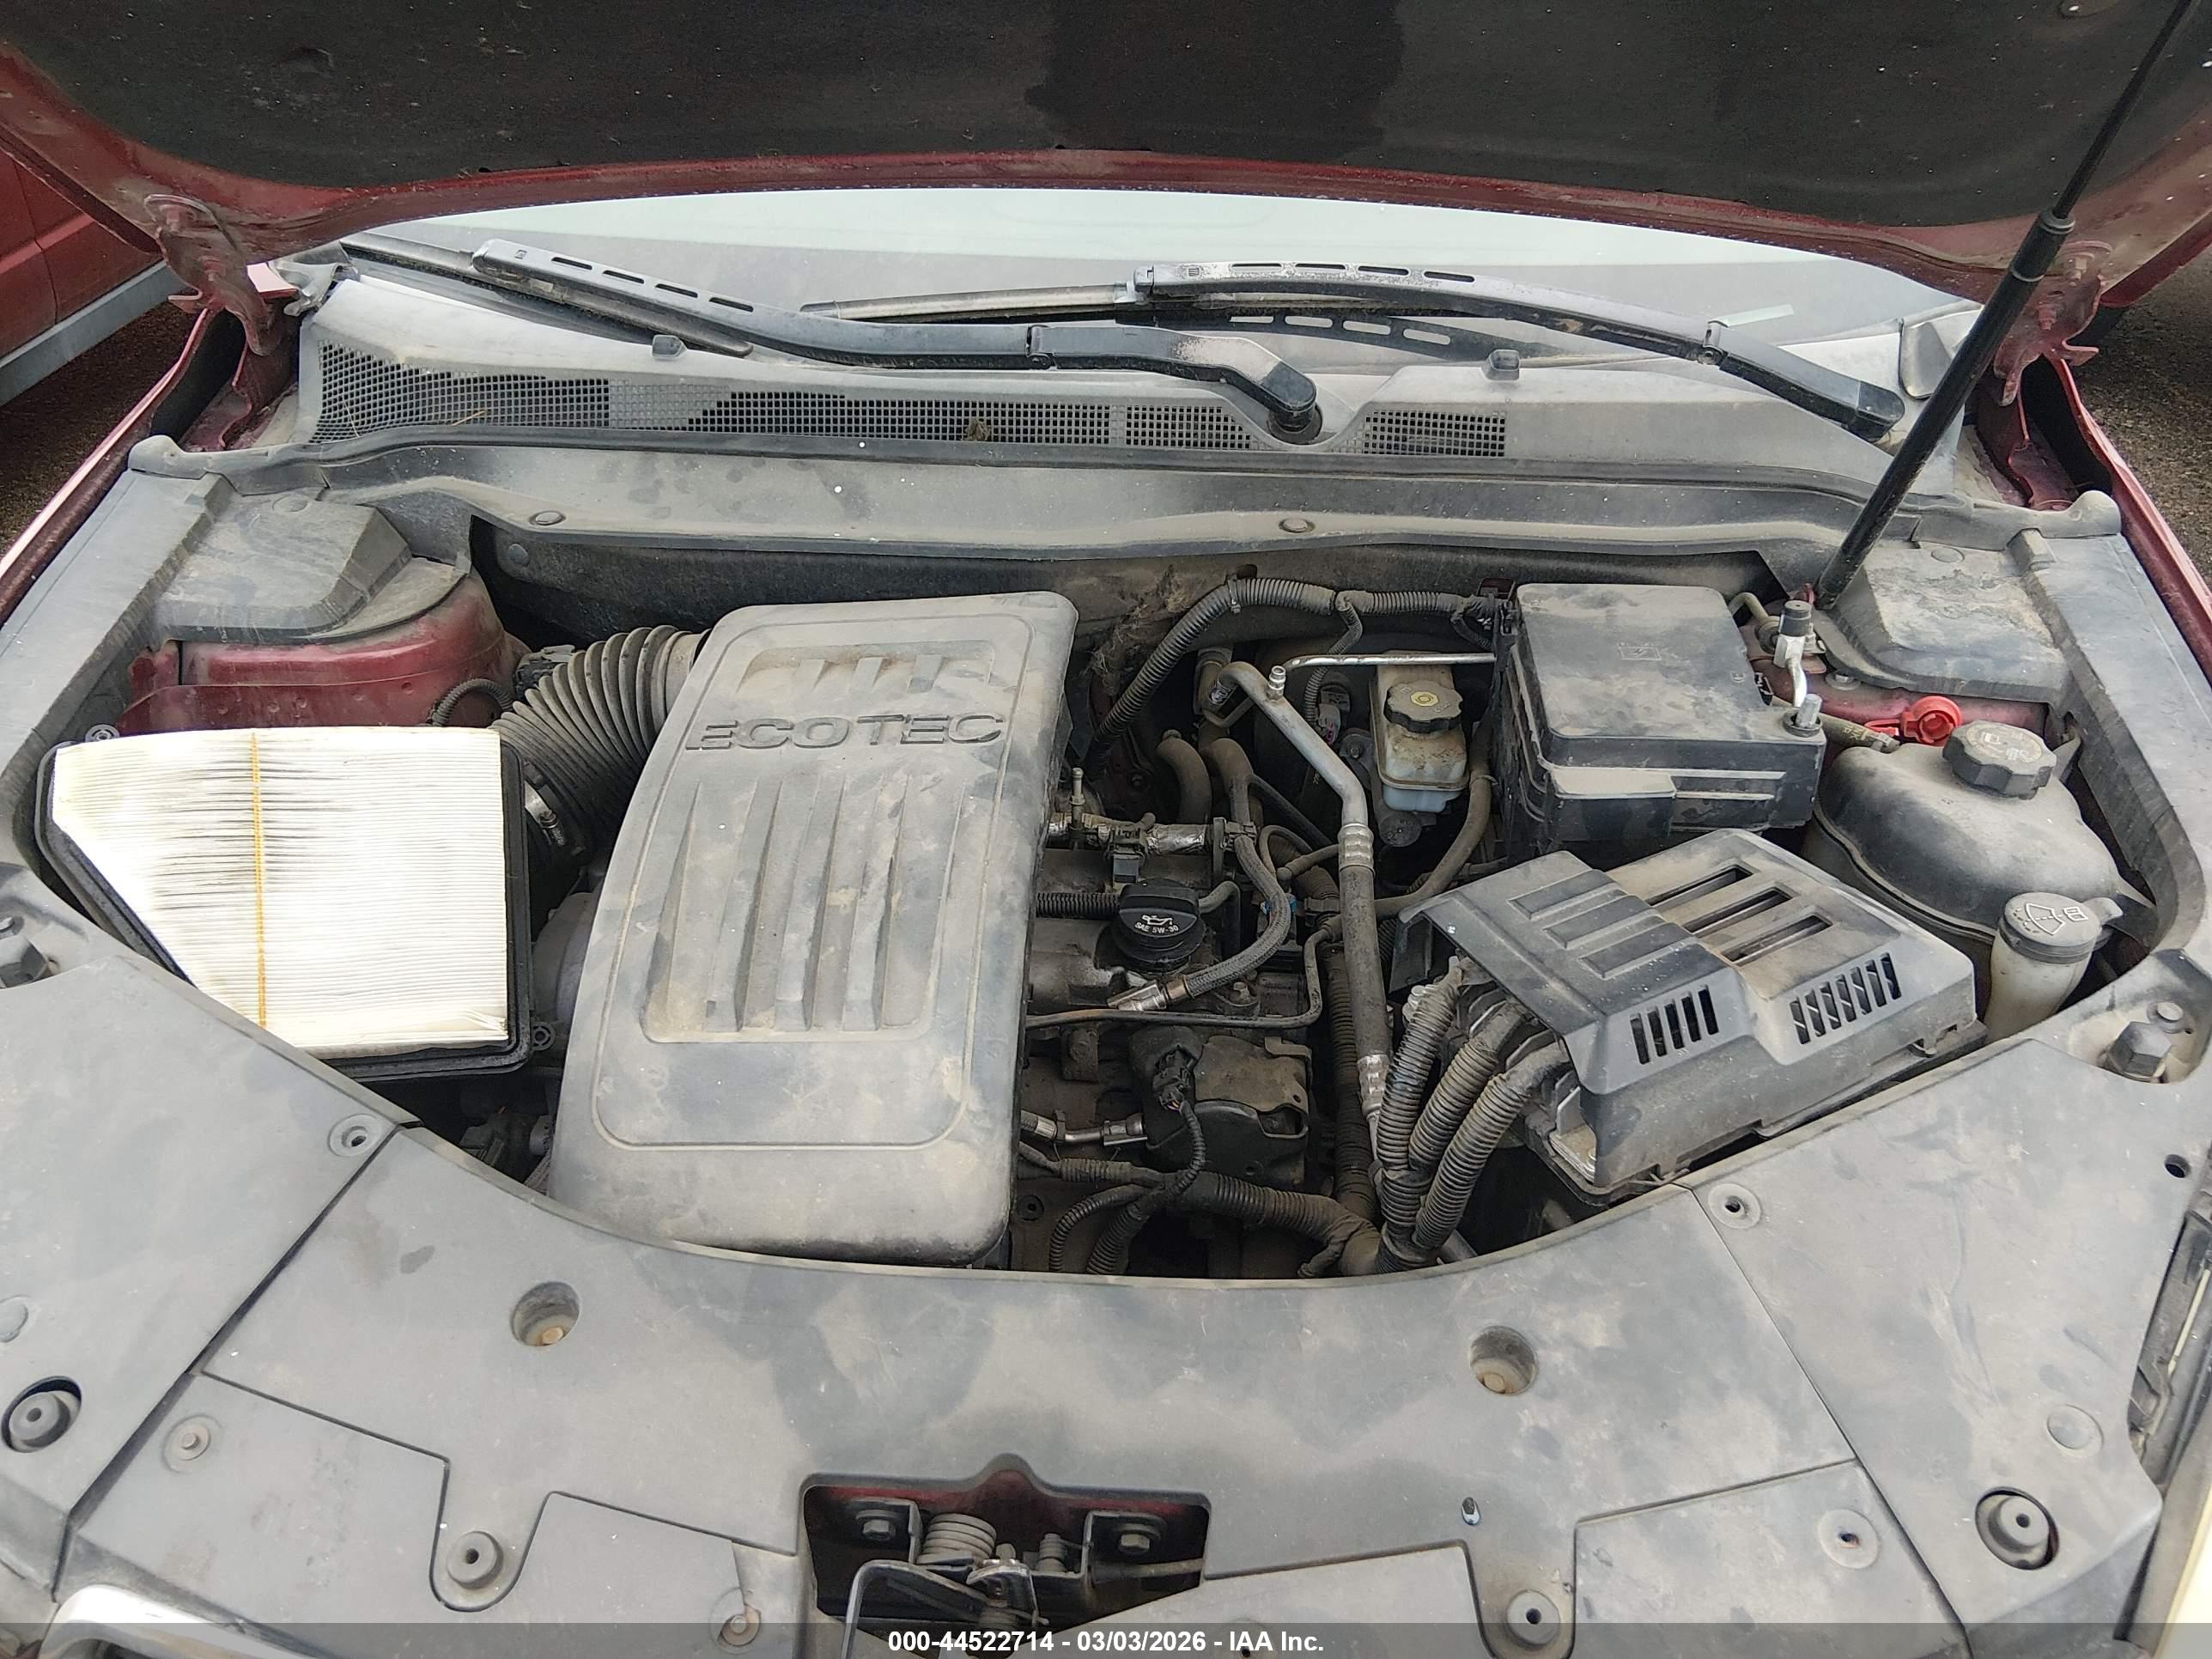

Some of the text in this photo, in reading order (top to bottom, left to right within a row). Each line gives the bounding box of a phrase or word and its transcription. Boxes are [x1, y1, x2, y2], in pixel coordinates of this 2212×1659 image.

[685, 713, 1005, 750] ECOTEC
[1134, 921, 1179, 934] SAE 5W-30
